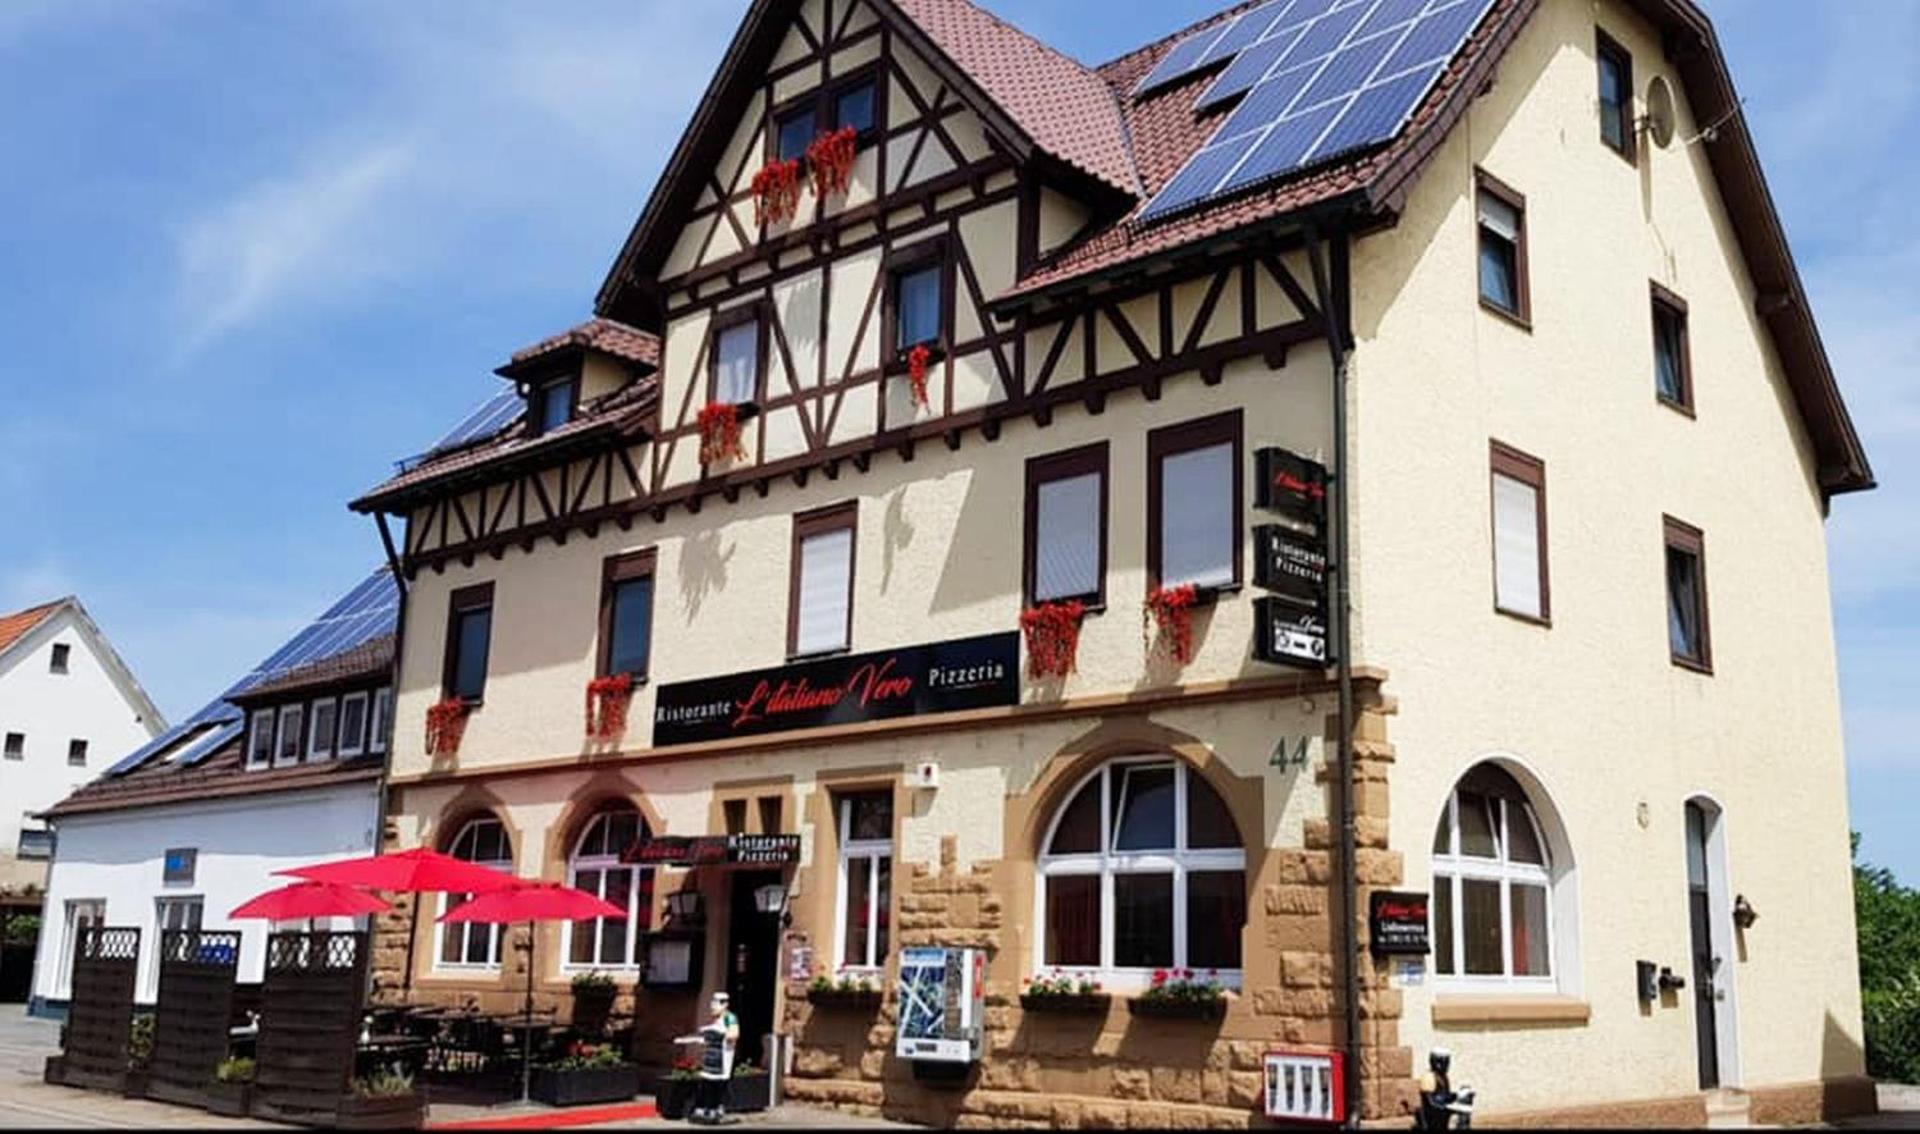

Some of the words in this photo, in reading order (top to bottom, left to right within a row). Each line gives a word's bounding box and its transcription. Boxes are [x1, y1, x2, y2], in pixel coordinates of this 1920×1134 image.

[1275, 555, 1322, 582] Pizzeria
[656, 701, 730, 722] Ristorante
[848, 657, 912, 709] Vero
[929, 660, 1003, 686] Pizzeria
[1269, 735, 1307, 775] 44
